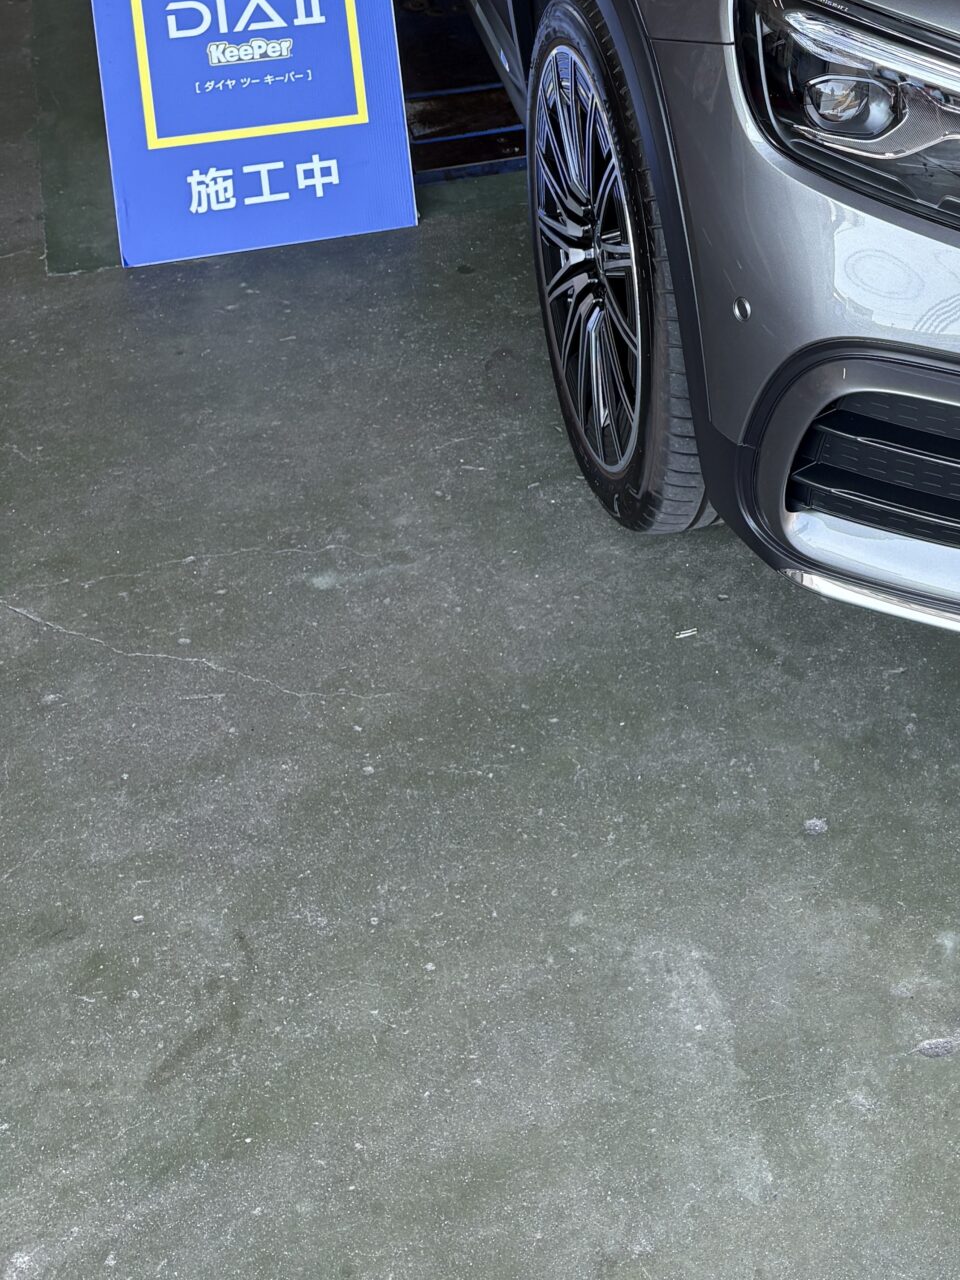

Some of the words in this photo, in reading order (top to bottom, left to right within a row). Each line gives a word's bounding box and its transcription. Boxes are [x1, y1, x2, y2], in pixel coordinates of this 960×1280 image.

[207, 38, 293, 66] KeePer
[186, 154, 340, 215] 施工中
